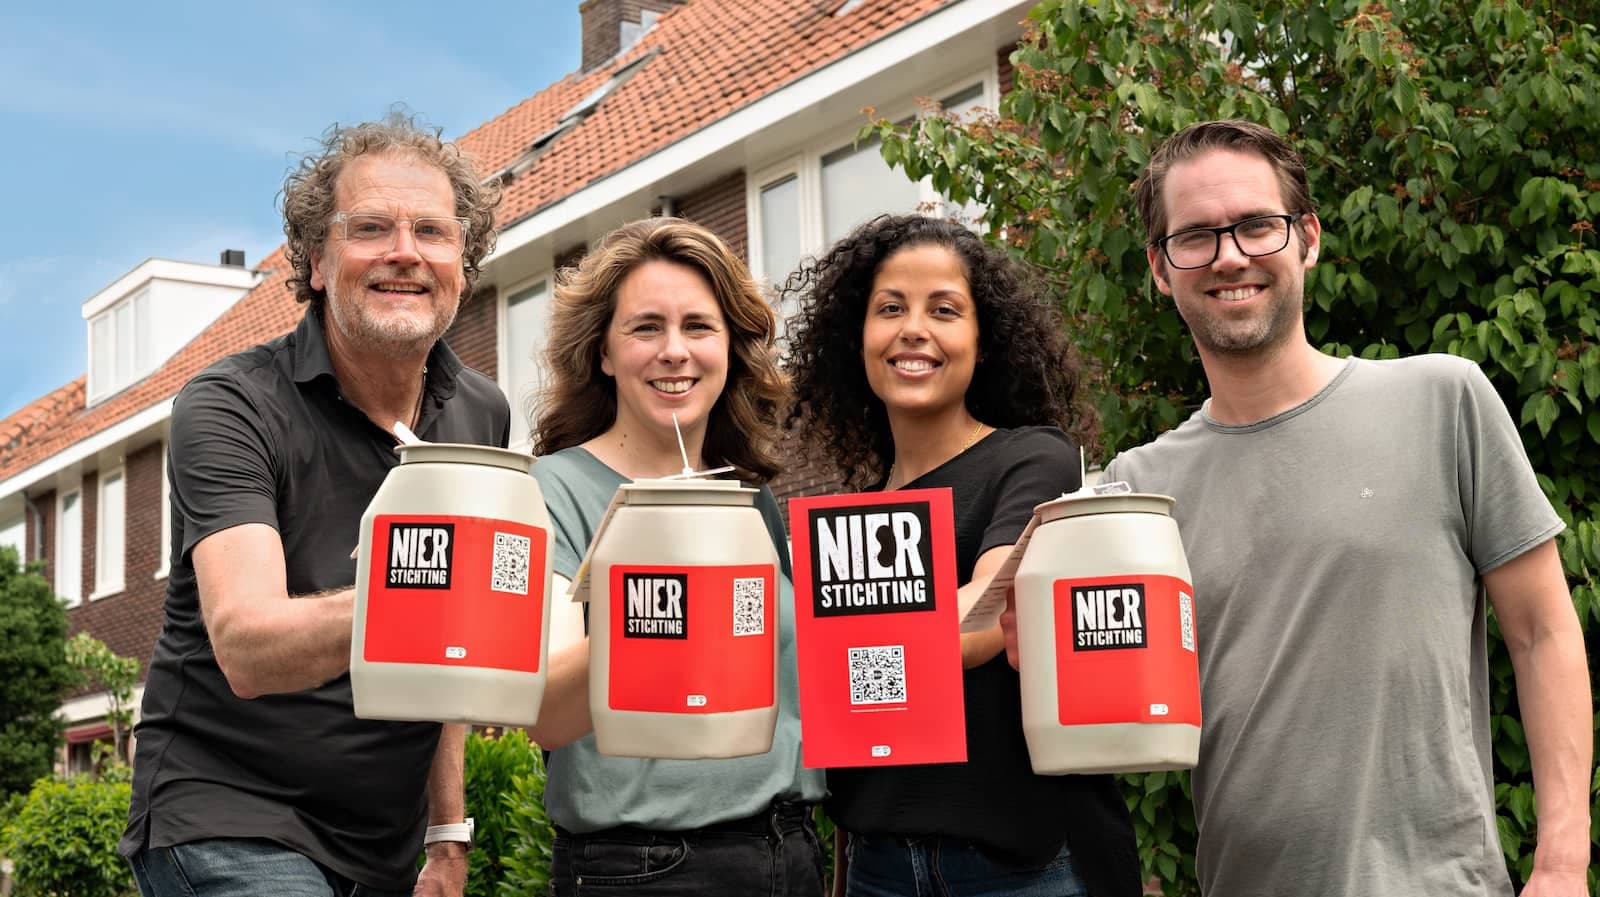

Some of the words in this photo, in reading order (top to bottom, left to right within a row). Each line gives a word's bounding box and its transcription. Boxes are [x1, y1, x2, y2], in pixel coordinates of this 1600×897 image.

[391, 527, 448, 569] NIER
[817, 511, 925, 582] NIER
[390, 569, 447, 585] STICHTING
[820, 579, 927, 608] STICHTING
[628, 578, 683, 618] NIER
[1076, 589, 1142, 631] NIER
[628, 618, 683, 635] STICHTING
[1077, 629, 1142, 647] STICHTING
